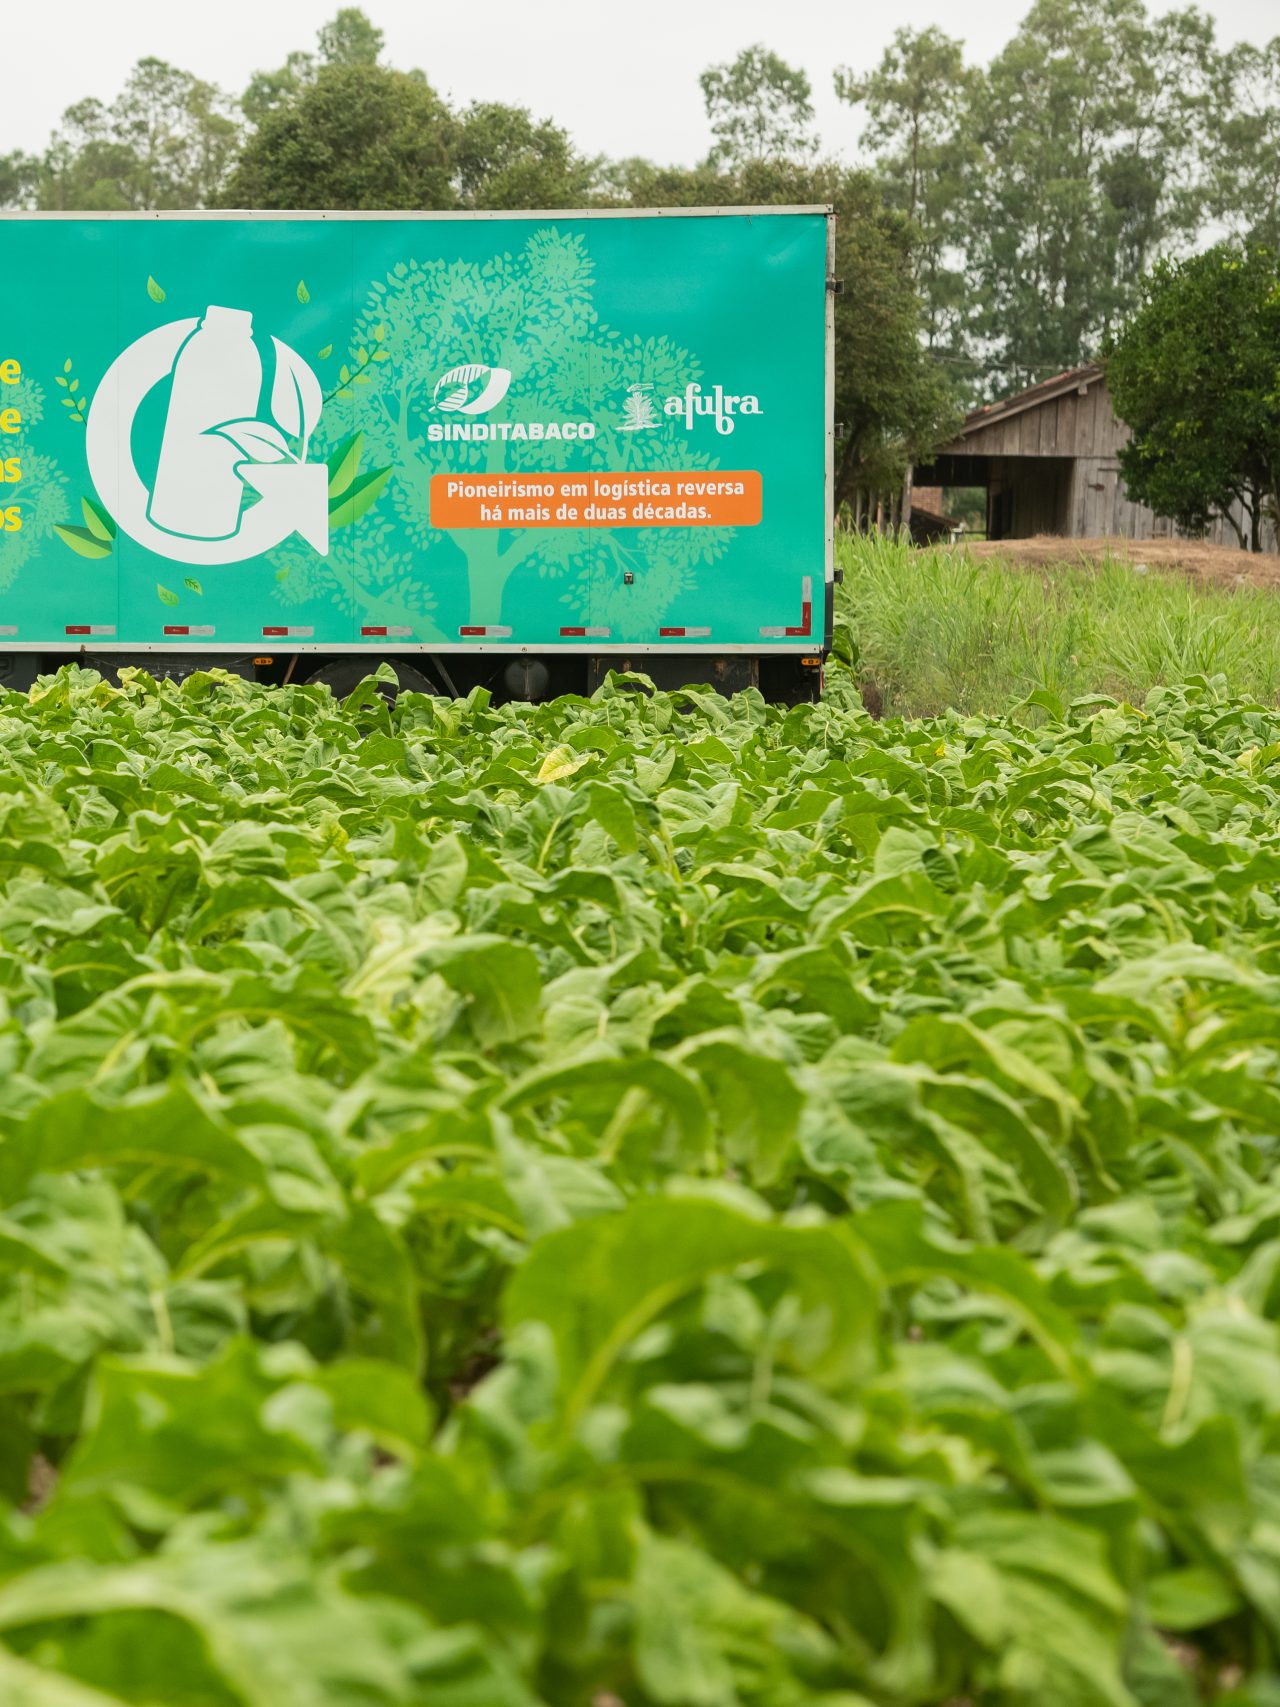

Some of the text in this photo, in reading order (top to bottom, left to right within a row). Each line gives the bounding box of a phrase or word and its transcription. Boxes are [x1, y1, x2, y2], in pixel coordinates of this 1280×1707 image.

[663, 382, 764, 435] afubra
[427, 422, 595, 441] SINDITABACO
[447, 479, 745, 500] Pioneirismo em logística reversa
[480, 501, 712, 521] há mais de duas décadas.
